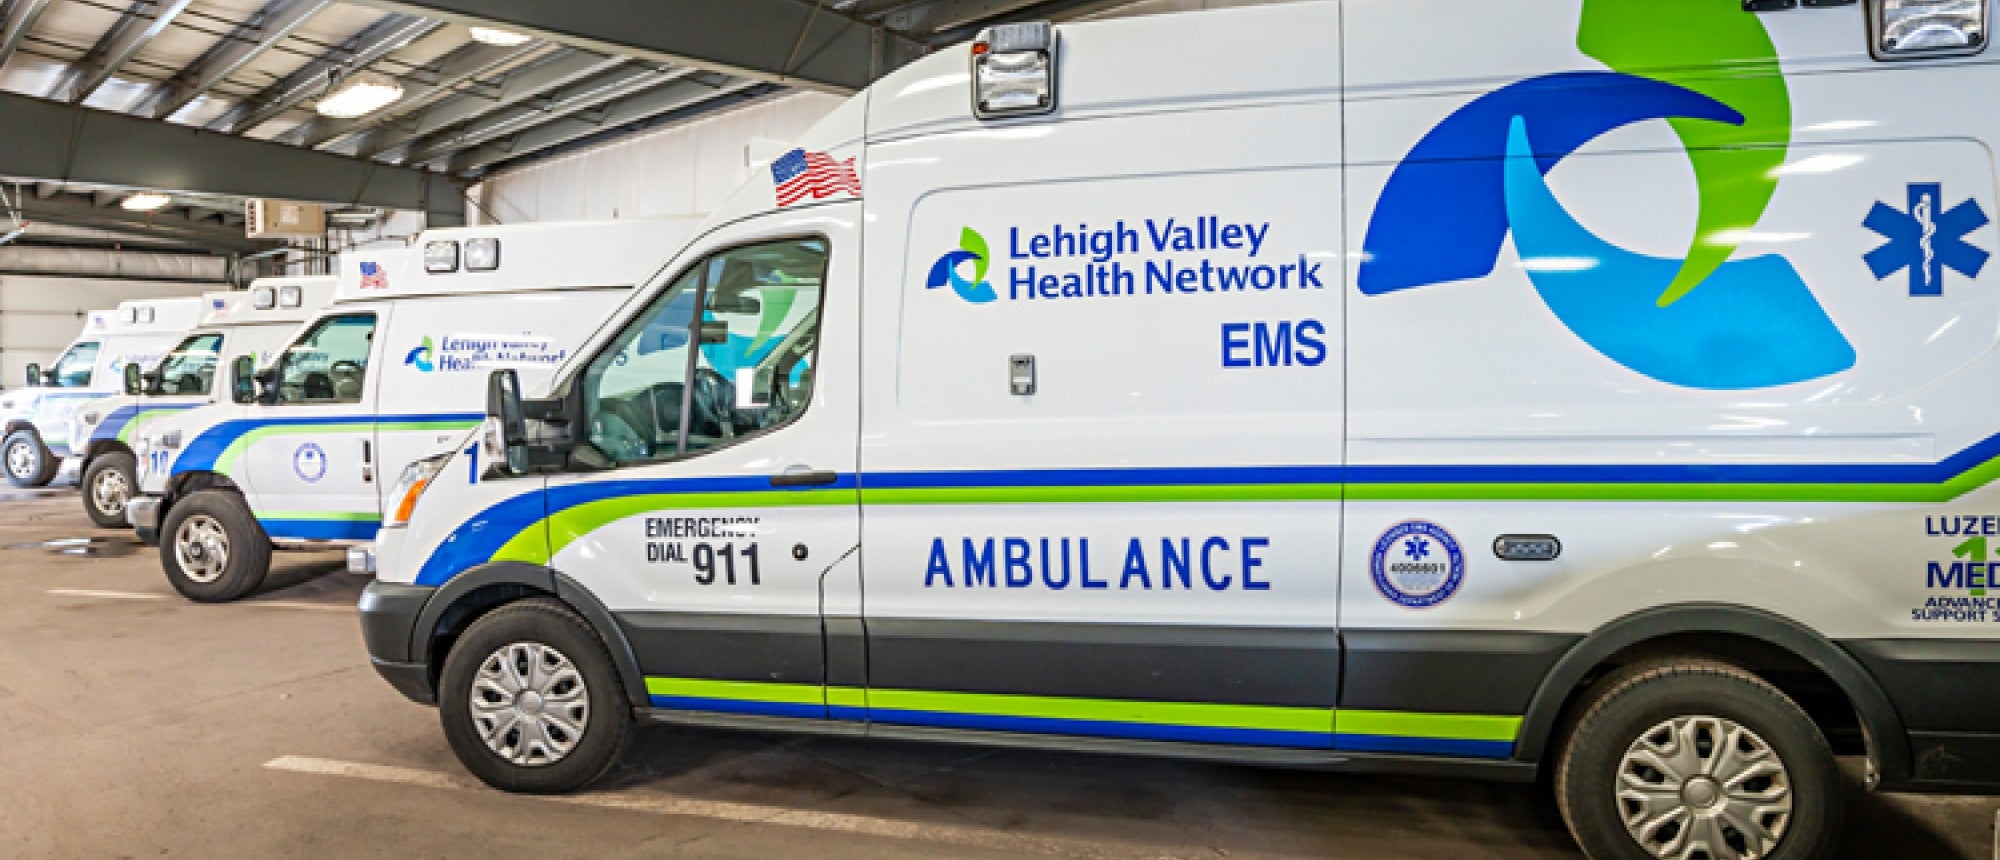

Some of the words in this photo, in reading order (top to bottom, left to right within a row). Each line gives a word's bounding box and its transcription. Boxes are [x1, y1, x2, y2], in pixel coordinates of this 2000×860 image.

[1009, 219, 1139, 263] Lehigh
[1143, 214, 1270, 257] Valley
[1009, 261, 1135, 300] Health
[1144, 253, 1323, 295] Network
[1220, 318, 1327, 368] EMS
[1925, 515, 2000, 536] LUZE
[647, 542, 688, 563] DIAL
[693, 542, 760, 585] 911
[924, 536, 1272, 591] AMBULANCE
[1911, 608, 1986, 622] SUPPORT
